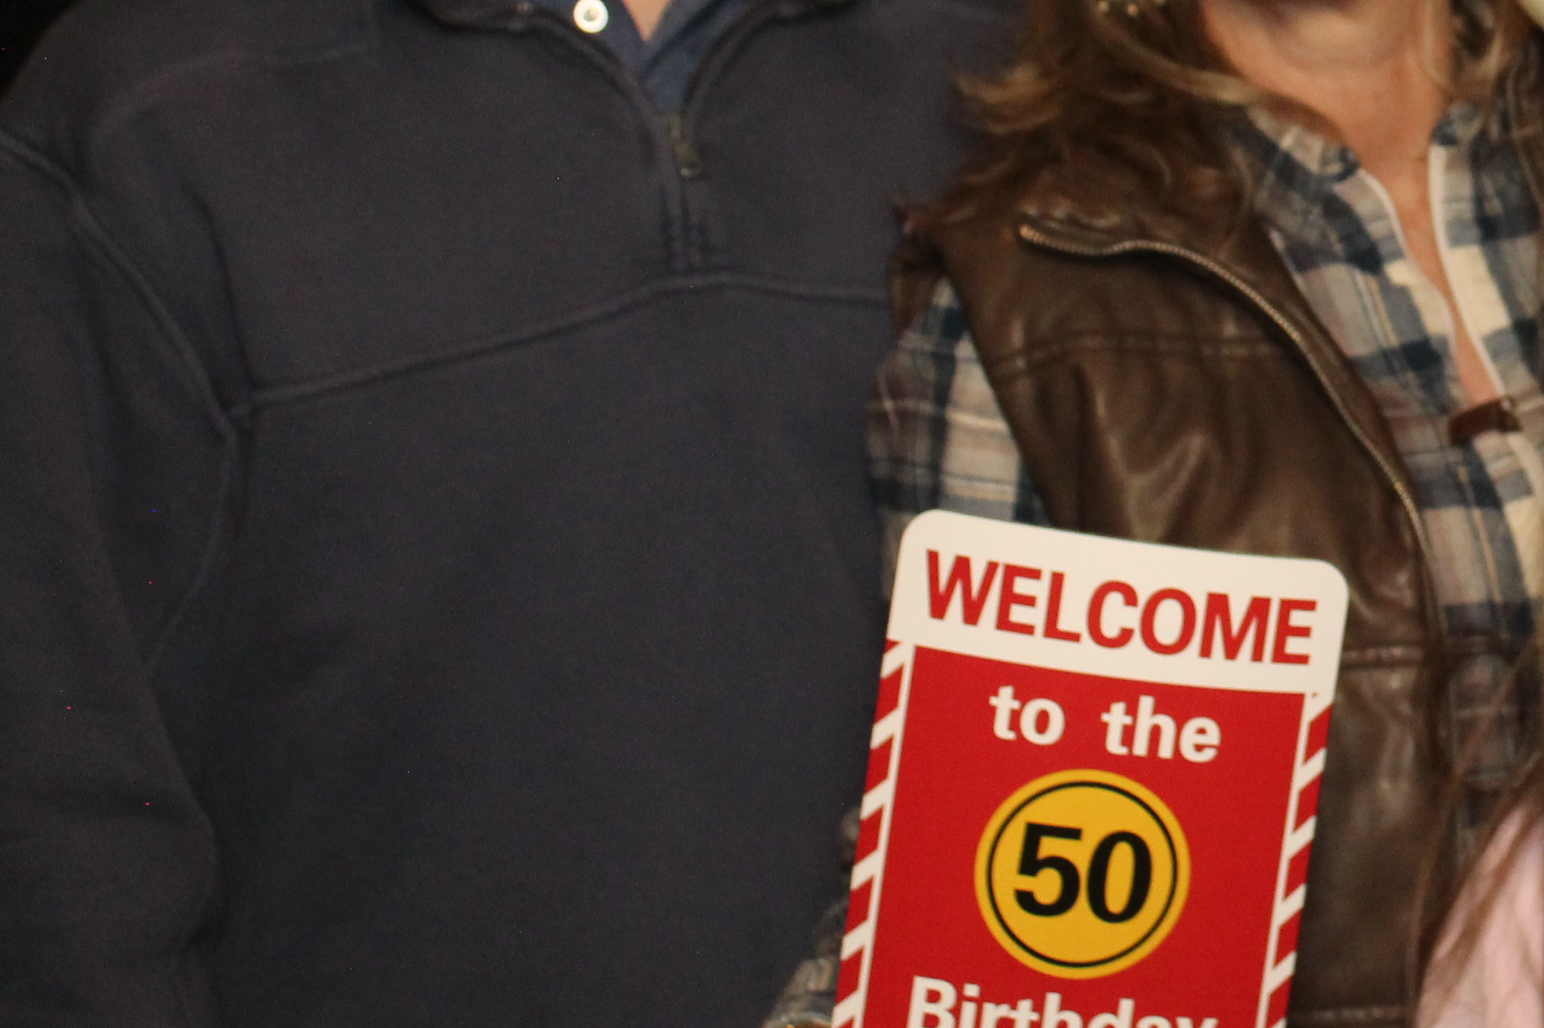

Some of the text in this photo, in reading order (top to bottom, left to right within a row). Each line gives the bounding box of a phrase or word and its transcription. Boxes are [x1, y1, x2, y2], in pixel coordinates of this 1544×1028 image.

[925, 549, 1317, 665] WELCOME
[989, 686, 1221, 762] to the
[1014, 821, 1152, 924] 50
[906, 975, 1219, 1028] Birthd
